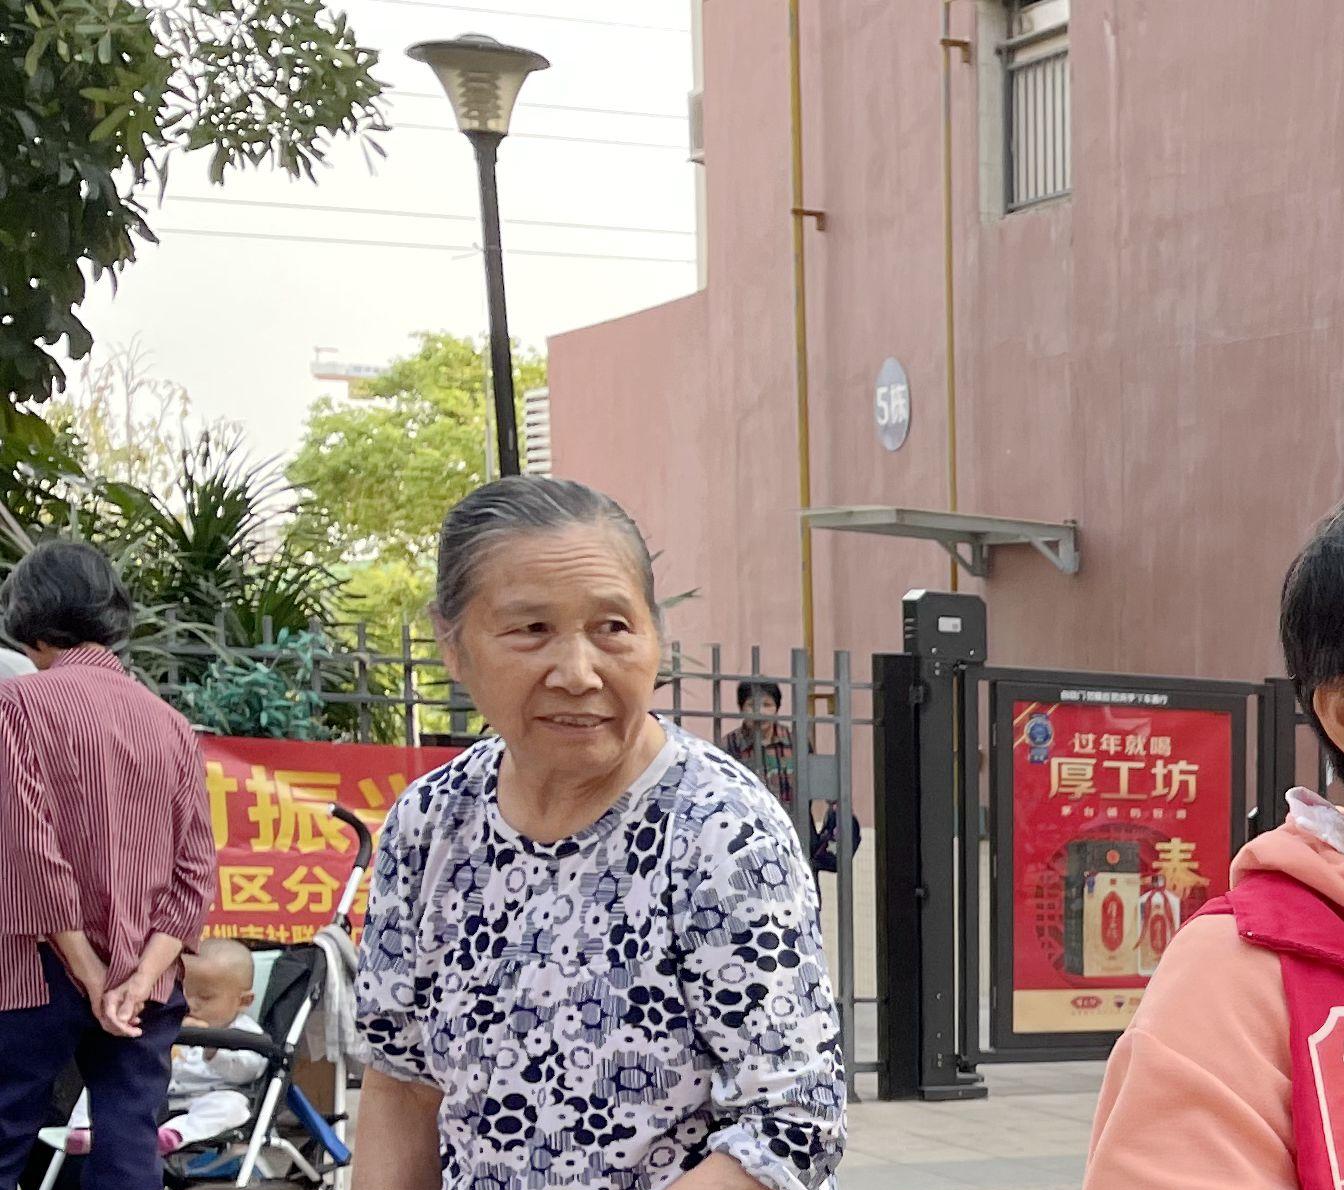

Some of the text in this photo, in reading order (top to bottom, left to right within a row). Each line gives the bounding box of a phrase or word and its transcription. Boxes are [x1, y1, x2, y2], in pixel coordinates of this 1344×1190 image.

[1072, 732, 1172, 757] 过年就喝
[1049, 757, 1200, 803] 厚工坊
